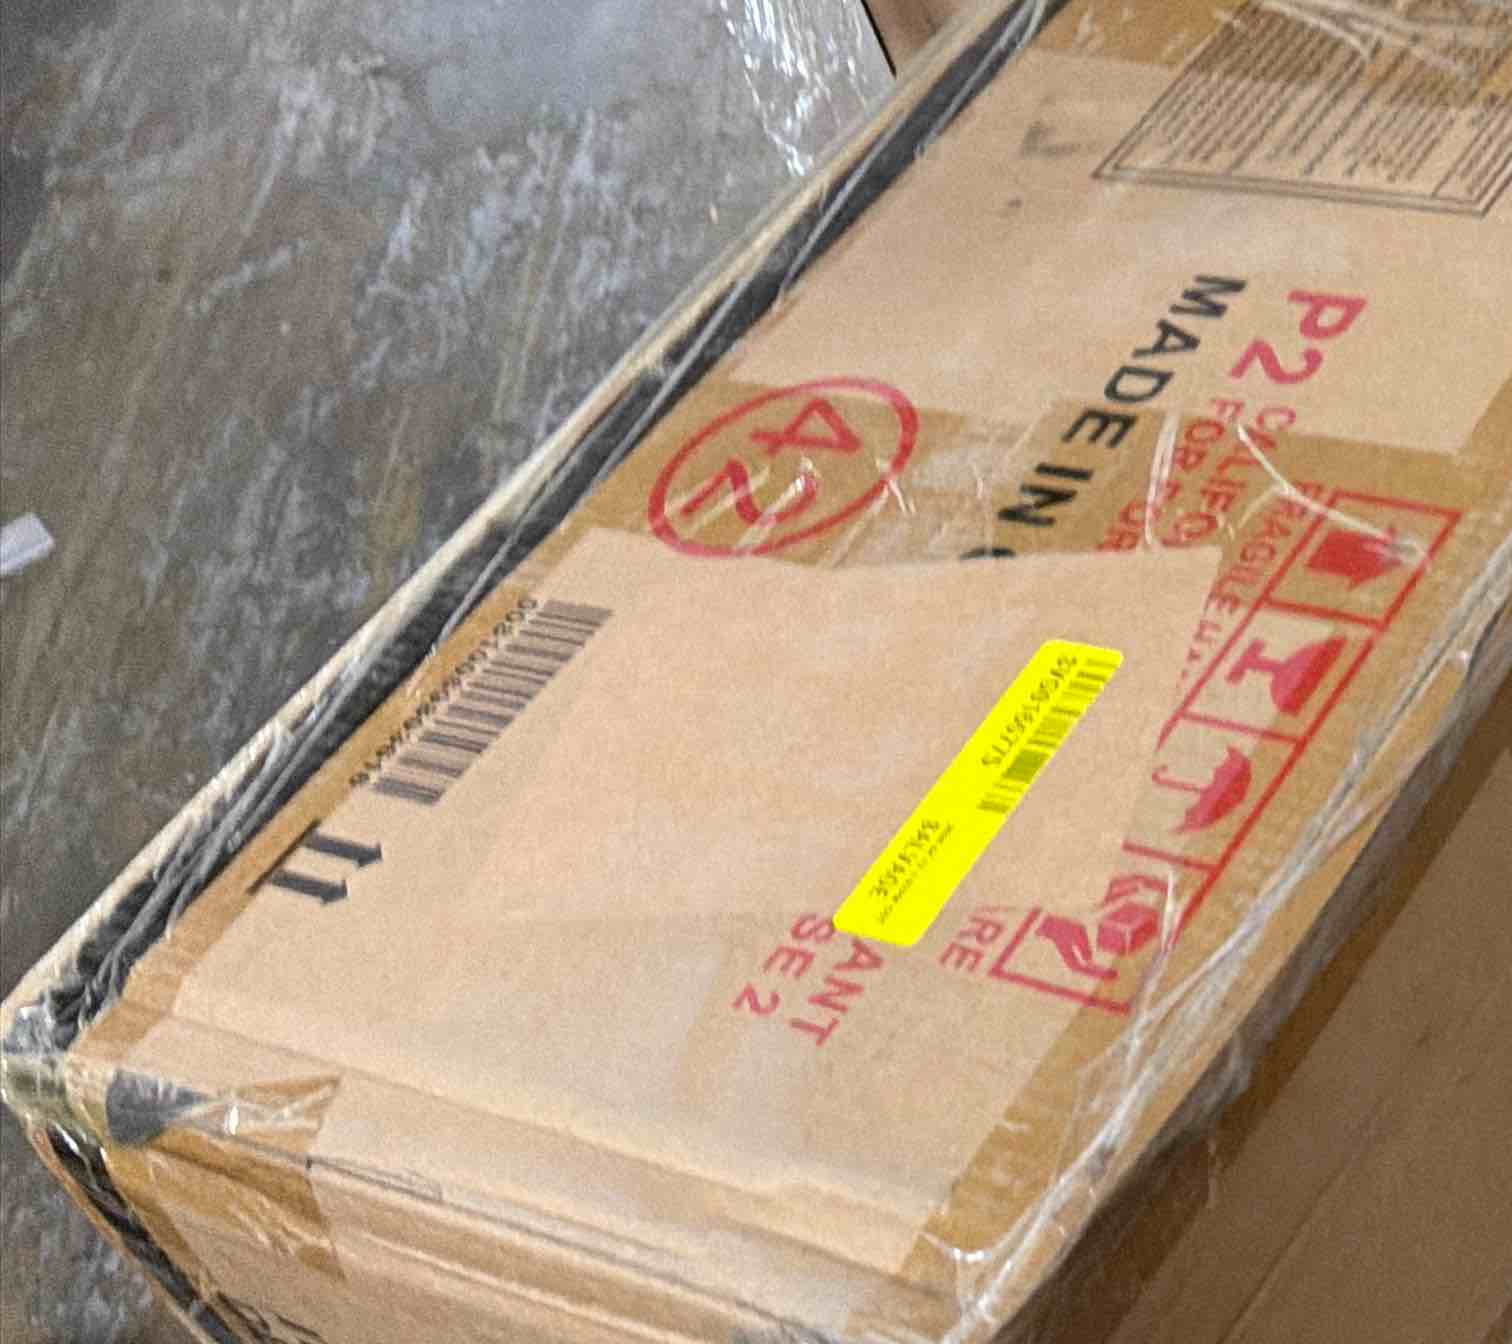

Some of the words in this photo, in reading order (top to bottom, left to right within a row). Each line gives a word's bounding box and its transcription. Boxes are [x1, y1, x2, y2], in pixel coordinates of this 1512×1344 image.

[1062, 274, 1247, 448] MADE
[1229, 290, 1368, 385] P2
[680, 399, 862, 529] 42
[998, 463, 1094, 529] IN
[1204, 482, 1328, 614] FRAGILE
[762, 912, 836, 980] SE
[787, 940, 886, 1047] ANT
[732, 987, 781, 1018] 2
